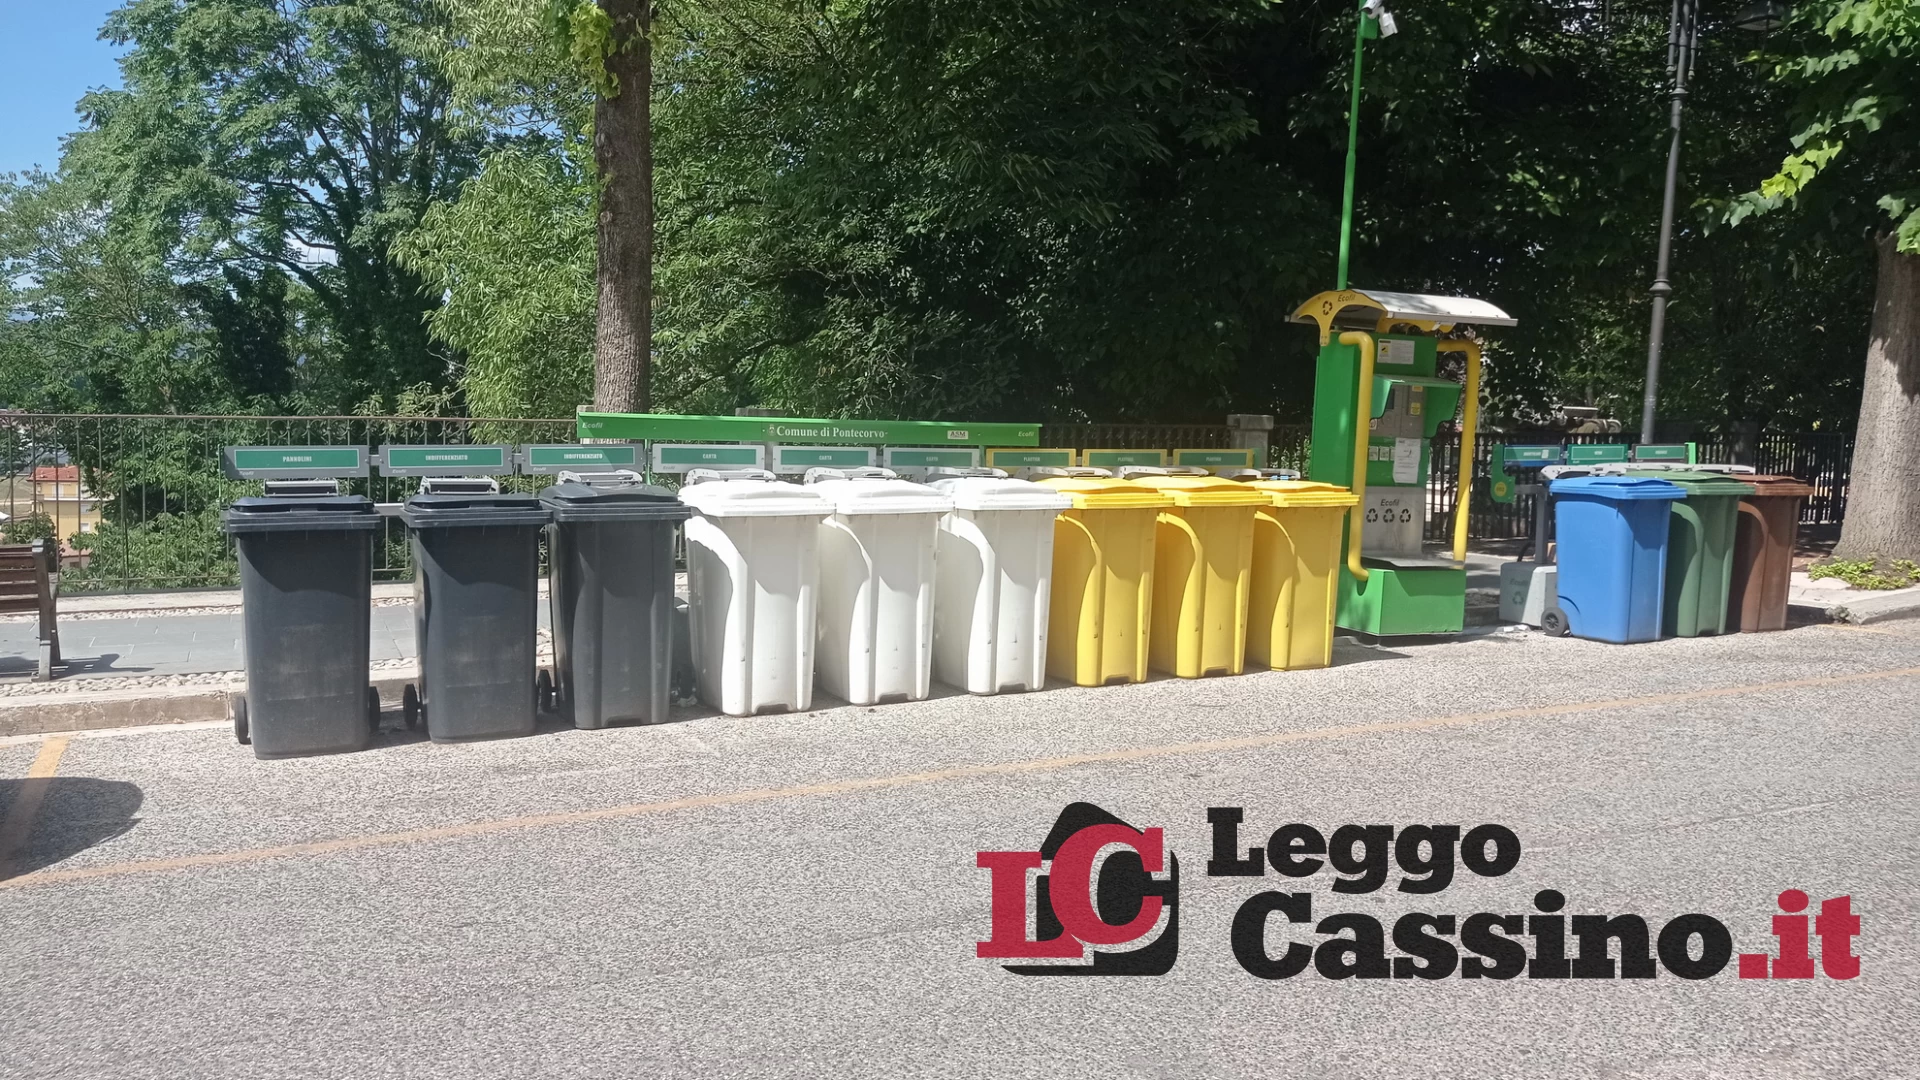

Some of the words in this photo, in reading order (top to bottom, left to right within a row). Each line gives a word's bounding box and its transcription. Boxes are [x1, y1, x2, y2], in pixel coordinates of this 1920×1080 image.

[1337, 294, 1356, 303] Ecofil
[776, 426, 818, 437] Comune
[820, 427, 830, 437] di
[833, 427, 885, 438] Pontecorvo
[1380, 498, 1400, 507] Ecofil
